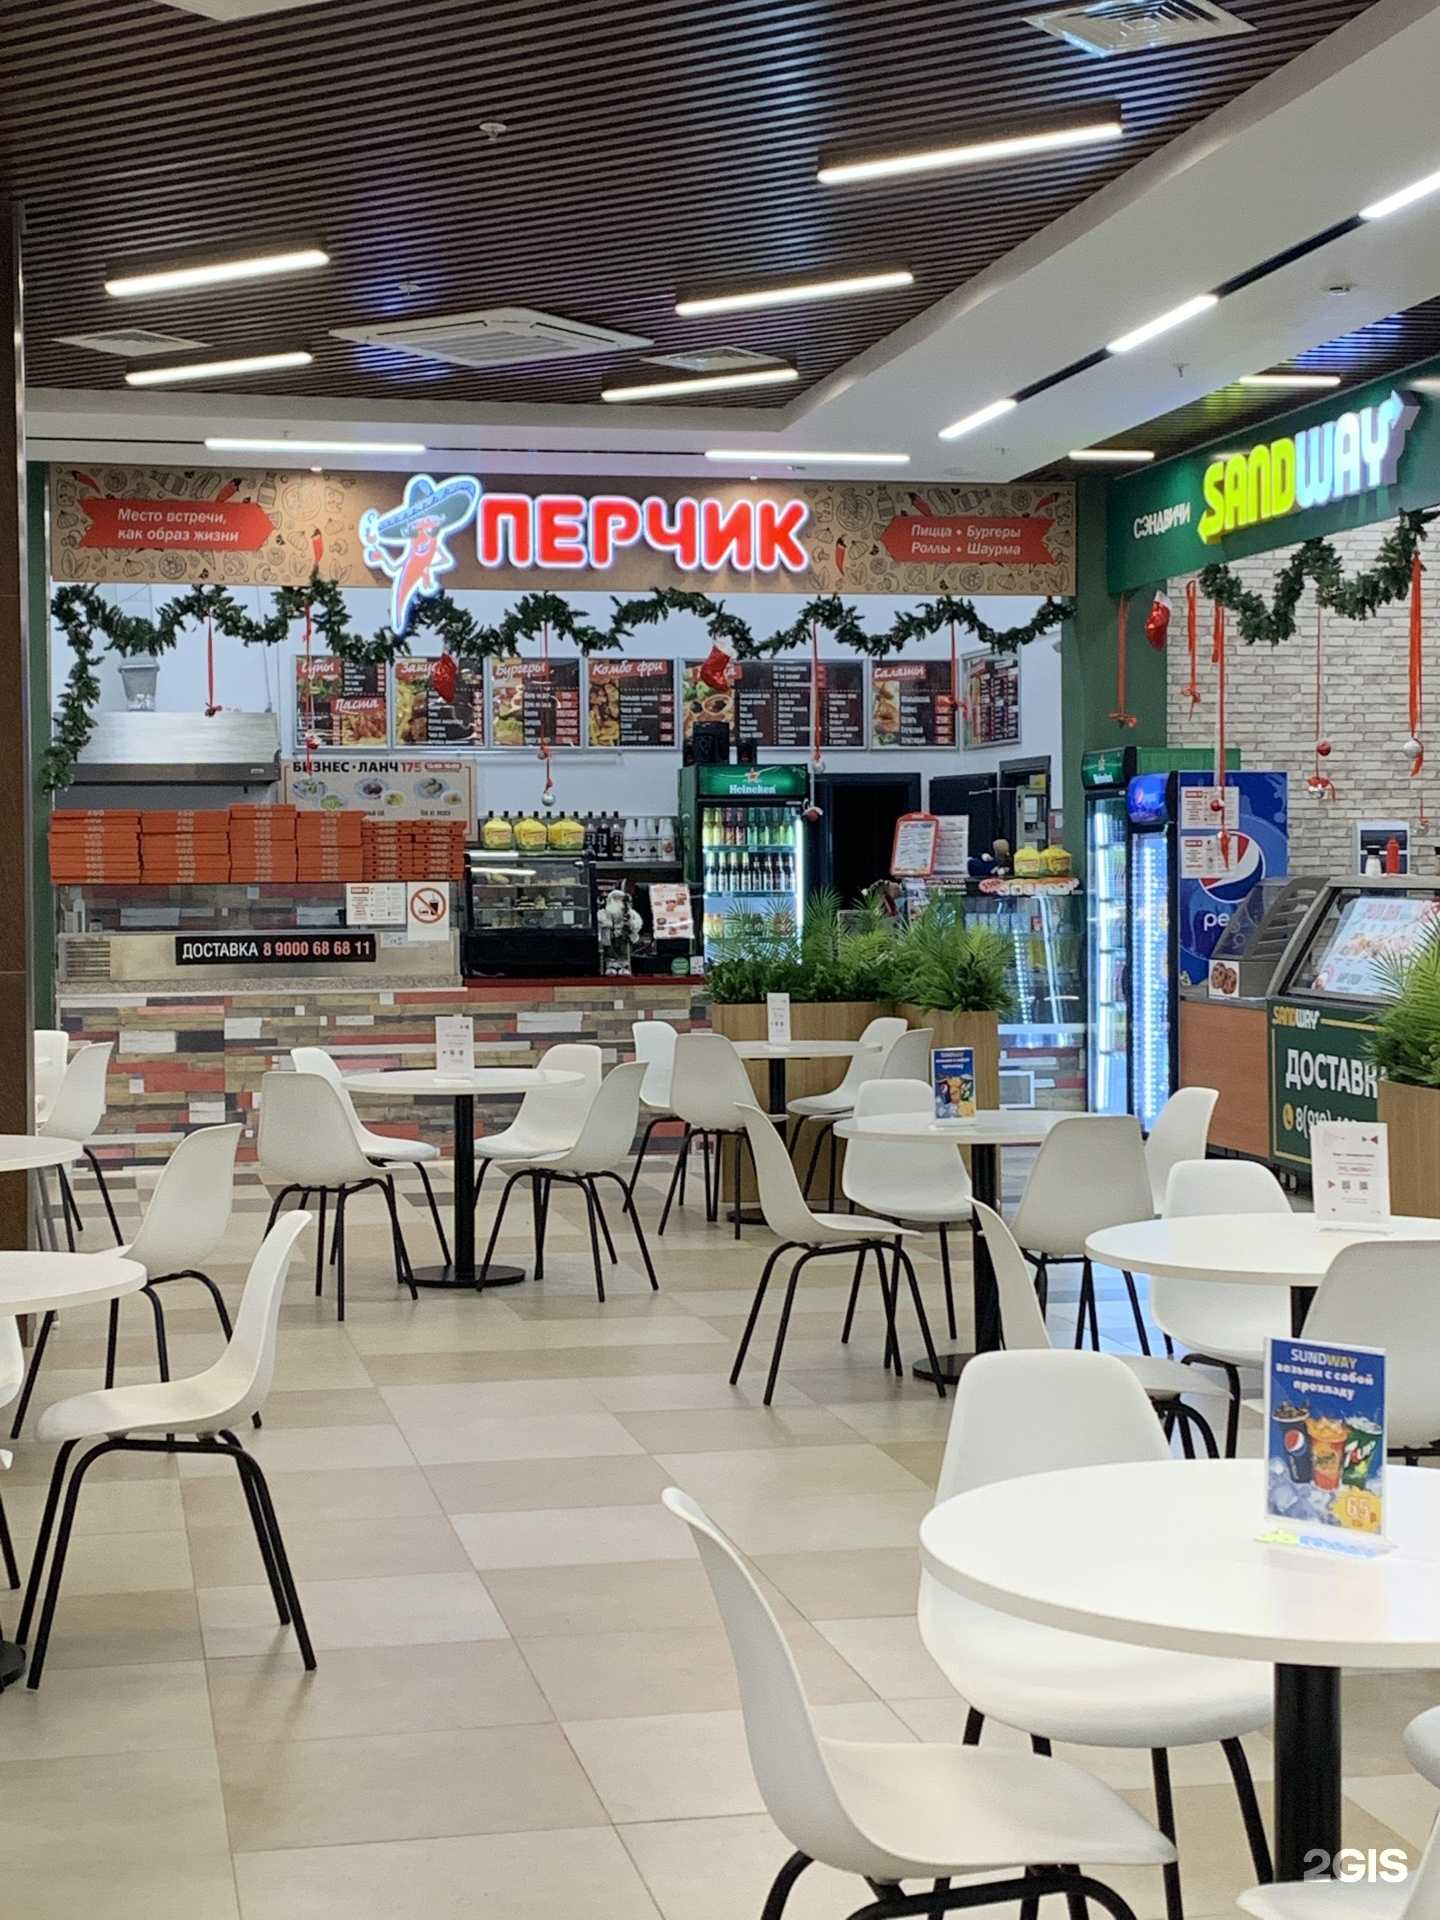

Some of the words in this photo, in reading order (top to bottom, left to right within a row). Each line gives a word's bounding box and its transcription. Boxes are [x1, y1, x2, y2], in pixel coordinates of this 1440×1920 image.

[1197, 390, 1405, 541] SANDWAY
[118, 508, 163, 523] Место
[167, 511, 227, 525] встречи,
[1133, 502, 1191, 539] СЭНДВИЧИ
[118, 528, 143, 539] как
[147, 528, 190, 543] образ
[194, 531, 239, 542] жизни
[478, 494, 809, 571] ПЕРЧИК
[911, 524, 952, 538] Пицца
[967, 525, 1021, 539] Бургеры
[911, 542, 951, 554] Роллы
[967, 543, 1021, 556] Шаурма
[495, 663, 546, 680] Бургеры
[592, 661, 632, 676] Комбо
[637, 660, 664, 677] фри
[335, 699, 380, 712] Паста
[358, 761, 398, 773] ЛАНЧ
[401, 762, 422, 773] 175
[729, 784, 777, 794] Heineken
[183, 942, 259, 959] ДОСТАВКА
[263, 943, 271, 956] 8
[275, 941, 309, 956] 9000
[312, 941, 330, 955] 68
[333, 941, 351, 955] 68
[354, 941, 371, 955] 11
[1285, 1048, 1381, 1099] ДОСТАВК
[1290, 1349, 1358, 1369] SUNDWAY
[1275, 1363, 1323, 1378] возьми
[1325, 1371, 1332, 1380] с
[1334, 1371, 1374, 1386] собой
[1293, 1380, 1355, 1401] прохладу
